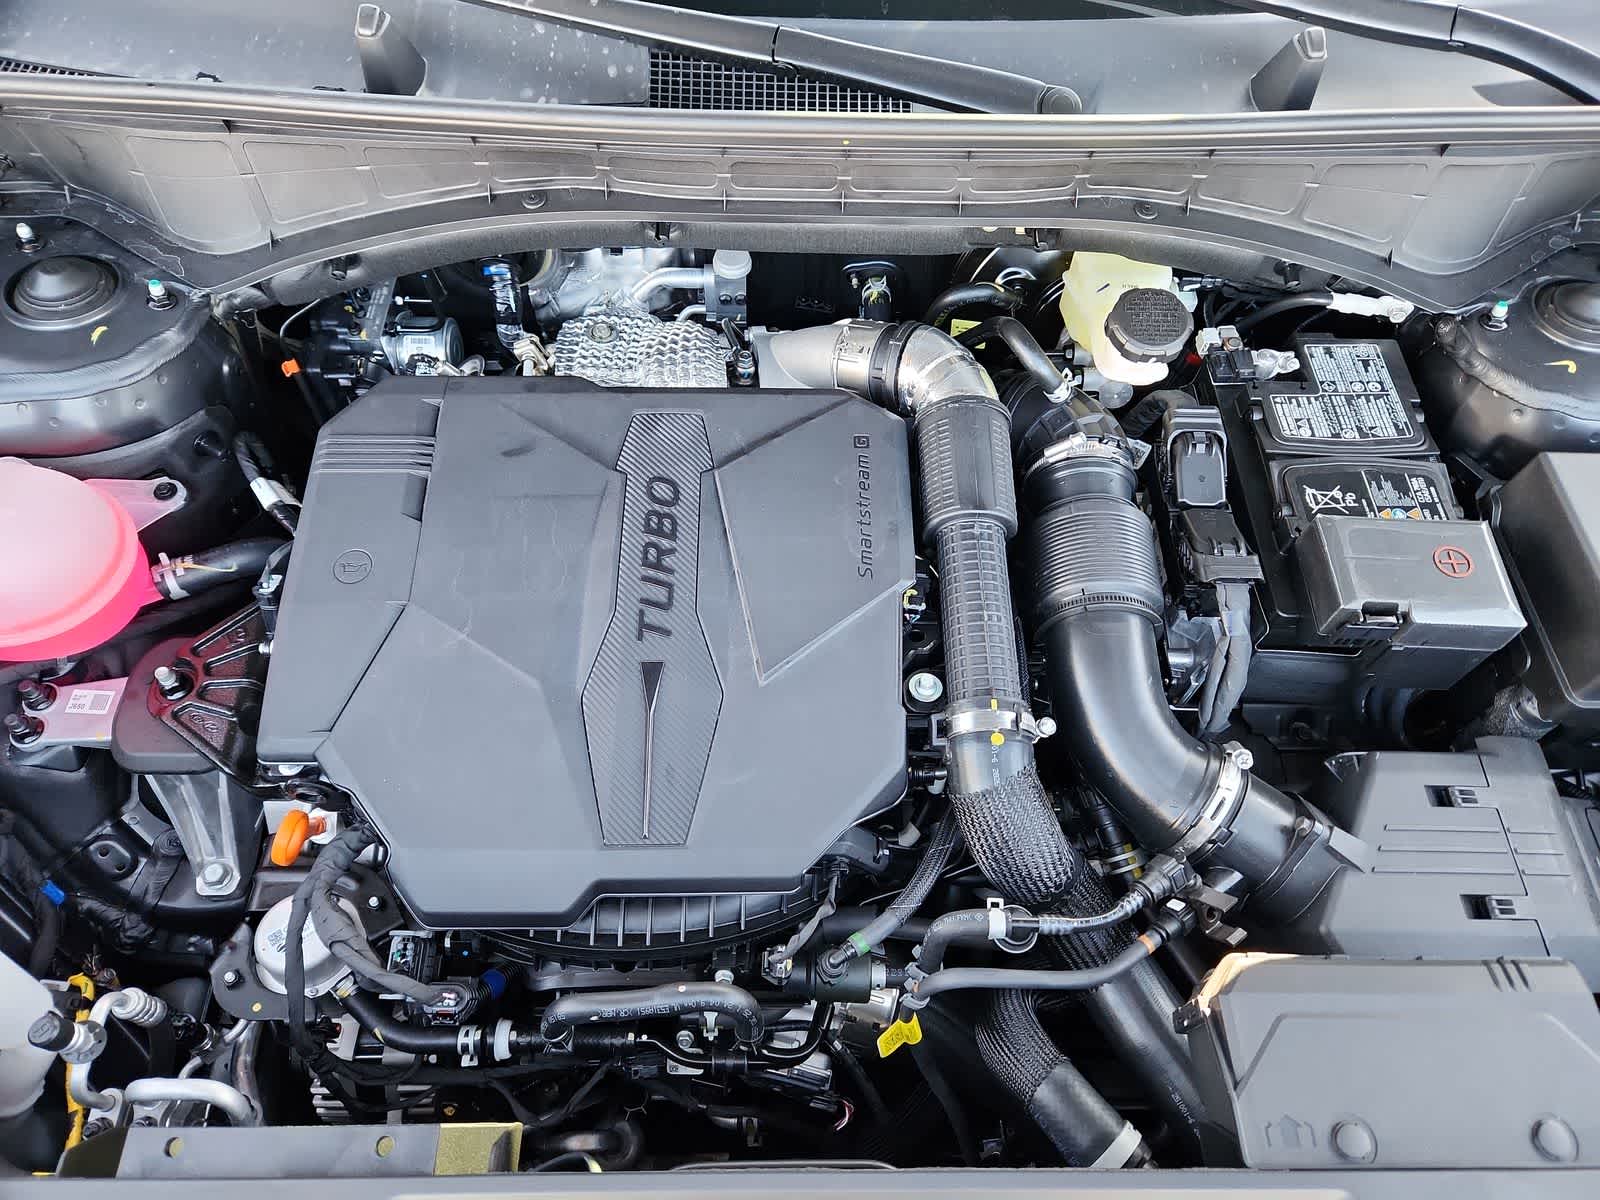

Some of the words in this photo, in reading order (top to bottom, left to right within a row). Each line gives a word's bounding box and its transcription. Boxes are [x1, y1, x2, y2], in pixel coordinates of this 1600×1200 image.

[636, 475, 680, 642] TURBO
[856, 453, 874, 580] Smartstream
[1344, 492, 1358, 507] Pb
